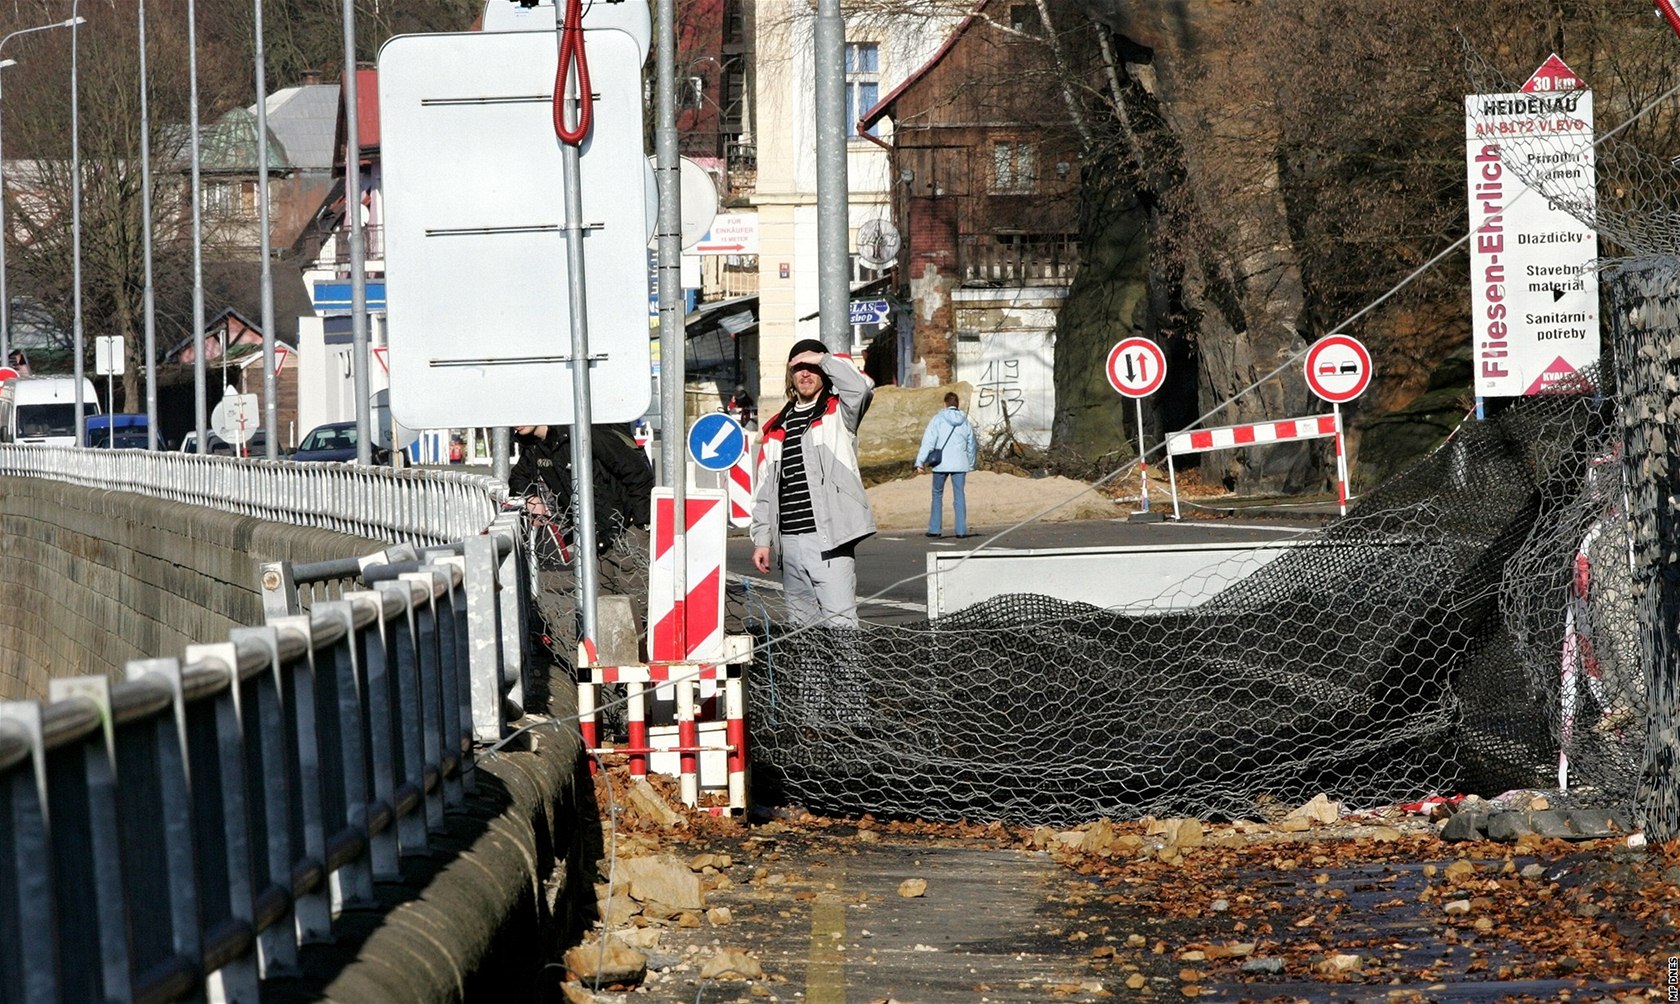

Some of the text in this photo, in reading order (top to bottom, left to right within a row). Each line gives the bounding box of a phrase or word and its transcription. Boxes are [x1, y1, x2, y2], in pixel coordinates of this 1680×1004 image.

[1533, 76, 1576, 91] 30 km
[1484, 97, 1577, 115] HEIDENAU
[1475, 119, 1584, 134] AN B172 VLEVO
[1518, 231, 1583, 245] Dlaždičky
[1475, 144, 1508, 378] Fliesen-Ehrlich
[1526, 264, 1584, 276] Stavební
[1526, 311, 1586, 325] Sanitární
[1537, 328, 1586, 341] potřeby
